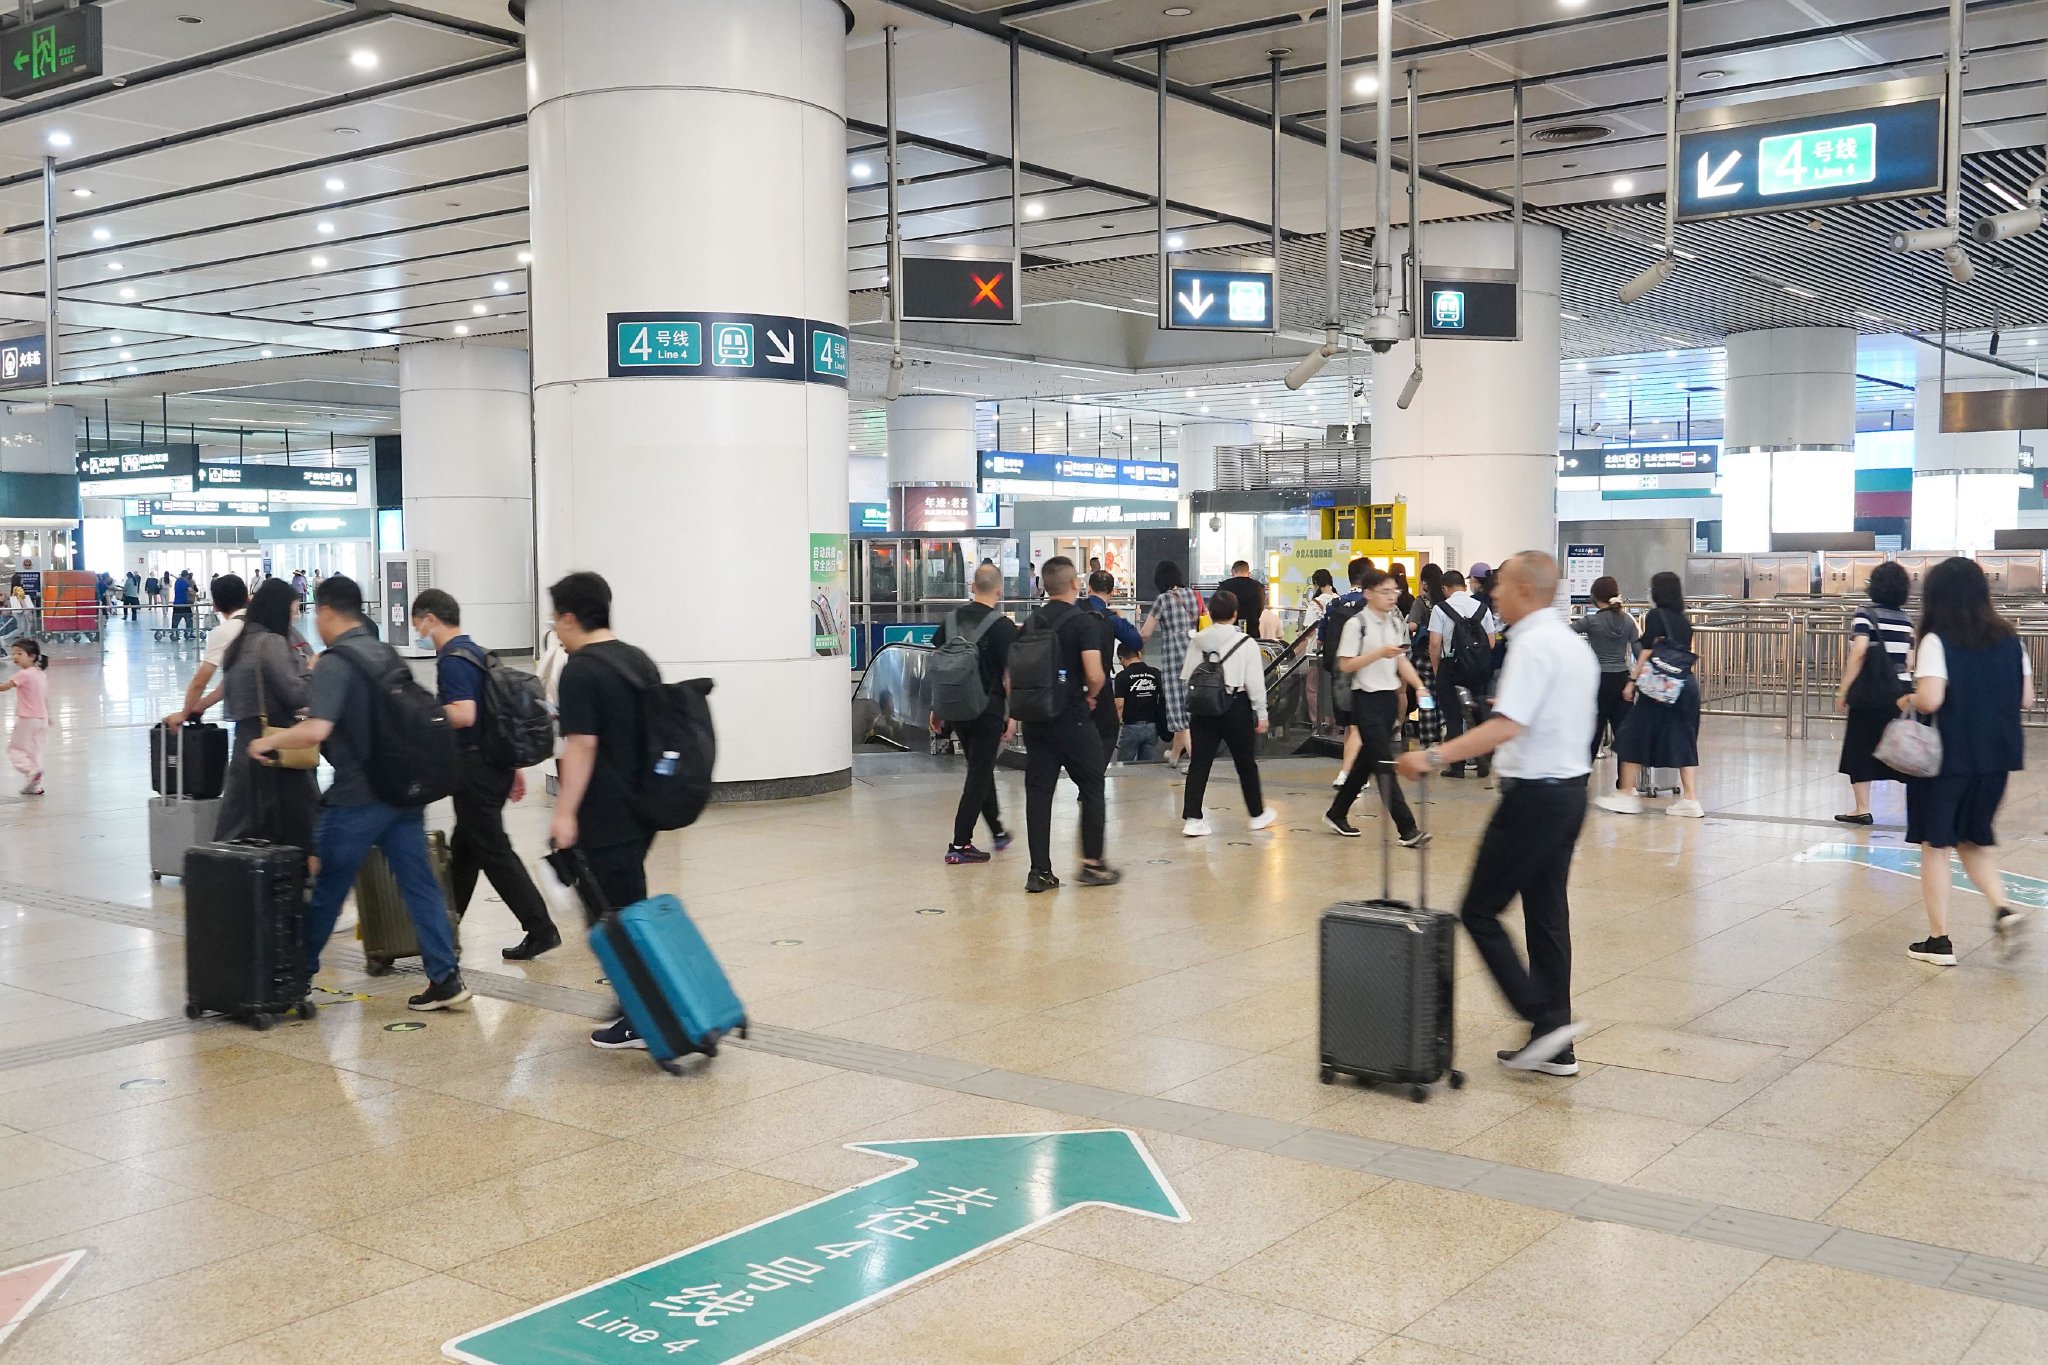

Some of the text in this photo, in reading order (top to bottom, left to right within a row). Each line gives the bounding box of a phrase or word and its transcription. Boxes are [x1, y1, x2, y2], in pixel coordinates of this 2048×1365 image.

[61, 55, 74, 65] EXIT
[1776, 138, 1858, 185] 4 号线
[1846, 163, 1856, 176] 4
[629, 326, 689, 361] 4 号线
[658, 350, 687, 359] Line 4
[820, 337, 833, 370] 4
[576, 1309, 700, 1355] Line 4
